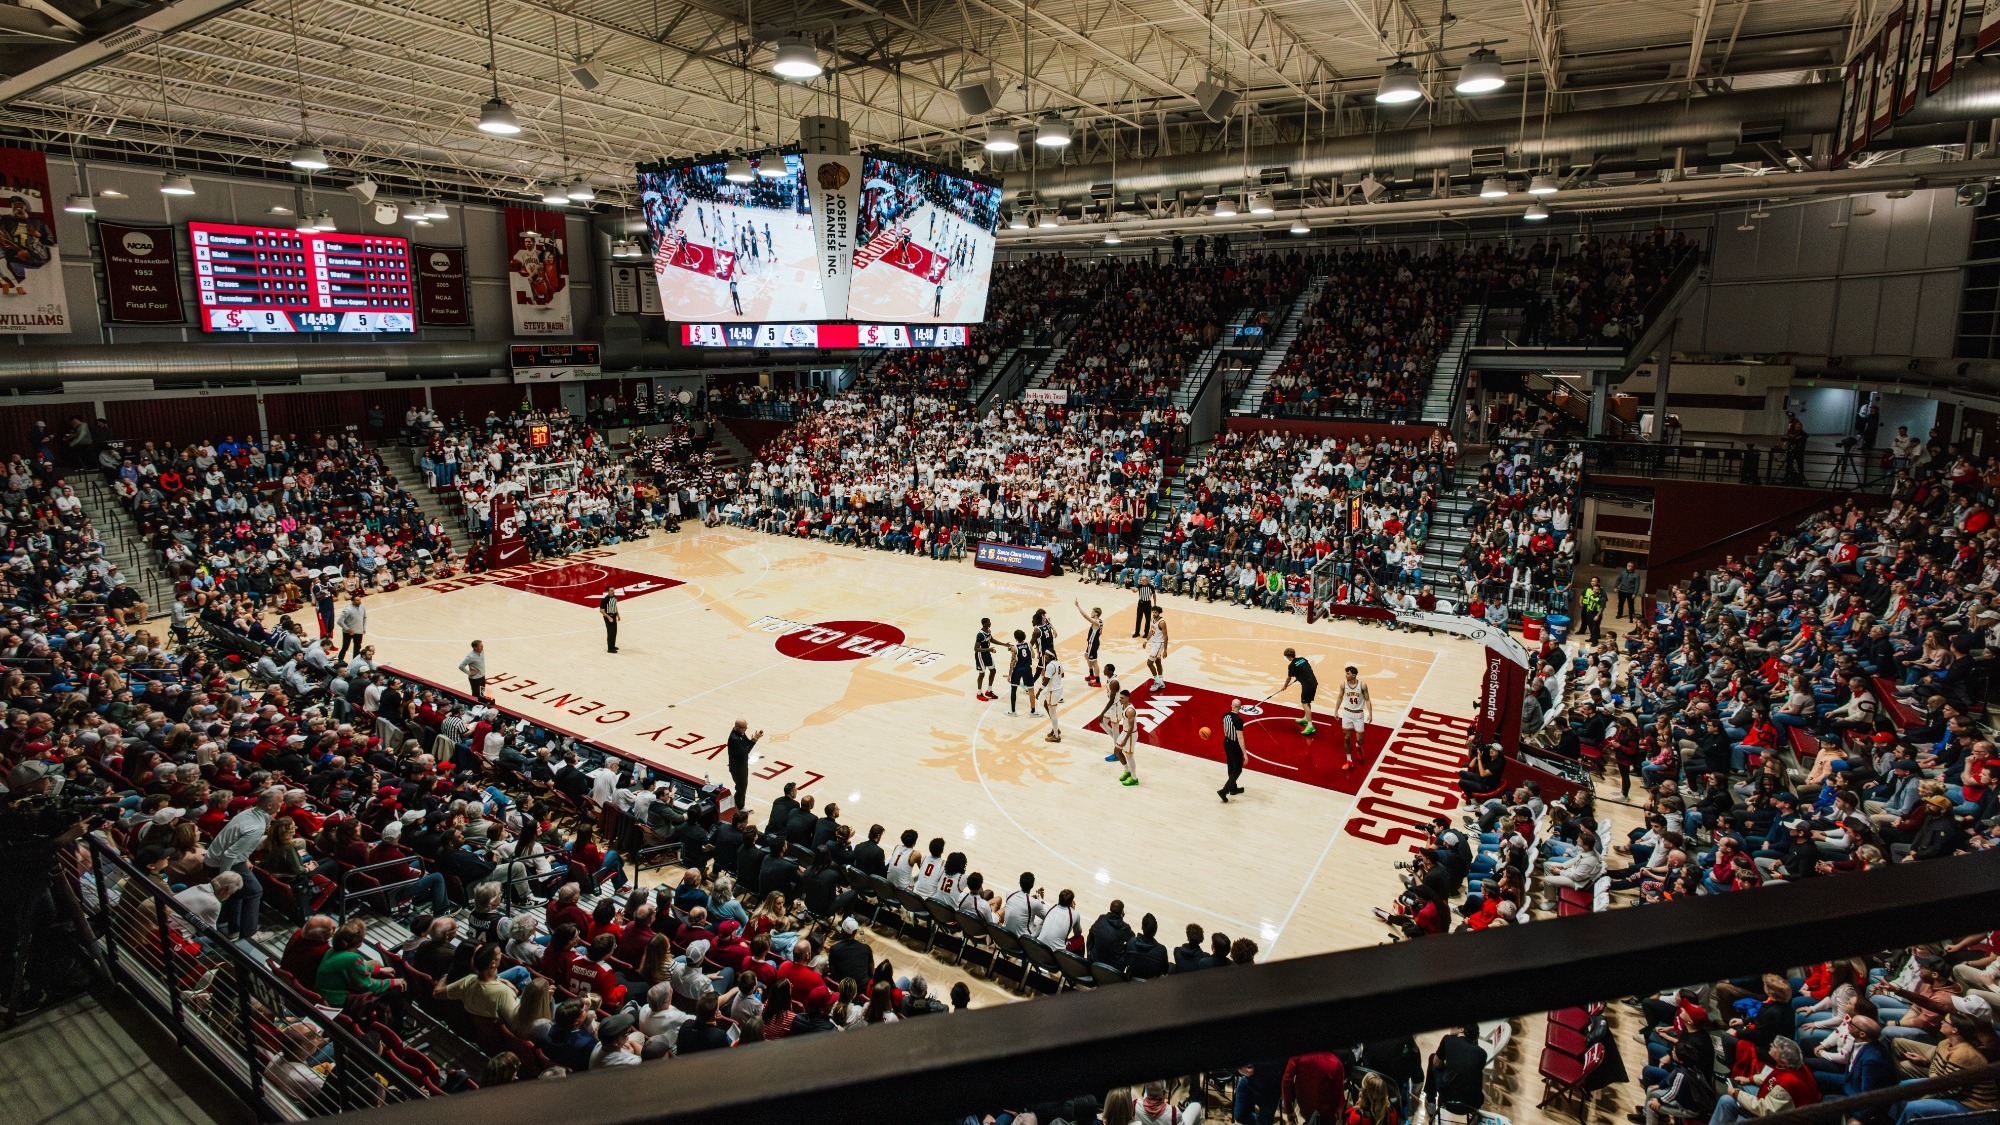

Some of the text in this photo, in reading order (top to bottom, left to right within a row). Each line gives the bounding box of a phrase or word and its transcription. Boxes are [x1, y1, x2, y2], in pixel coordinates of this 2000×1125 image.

[836, 194, 846, 238] JOSEPH
[826, 194, 836, 278] ALBANESE INC.
[838, 242, 846, 251] J.
[0, 314, 64, 326] WILLIAMS
[266, 312, 274, 325] 9
[300, 313, 336, 326] 14:48
[359, 314, 367, 326] 5
[712, 327, 716, 339] 9
[729, 328, 753, 340] 14:48
[768, 327, 774, 341] 5
[894, 327, 900, 341] 9
[914, 329, 934, 341] 14:48
[944, 328, 948, 341] 5
[529, 354, 593, 363] 9 5
[533, 433, 546, 444] 30
[1022, 553, 1045, 562] University
[420, 549, 617, 594] BRONCOS
[746, 615, 847, 644] CLARA
[837, 634, 946, 667] SANTA
[1022, 649, 1027, 657] 8
[1487, 658, 1501, 722] TicketSmarter
[484, 672, 631, 724] CENTER
[635, 725, 826, 791] LEVEY
[1344, 706, 1478, 854] BRONCOS
[894, 854, 901, 866] 1
[925, 863, 934, 876] 0
[940, 877, 953, 893] 12
